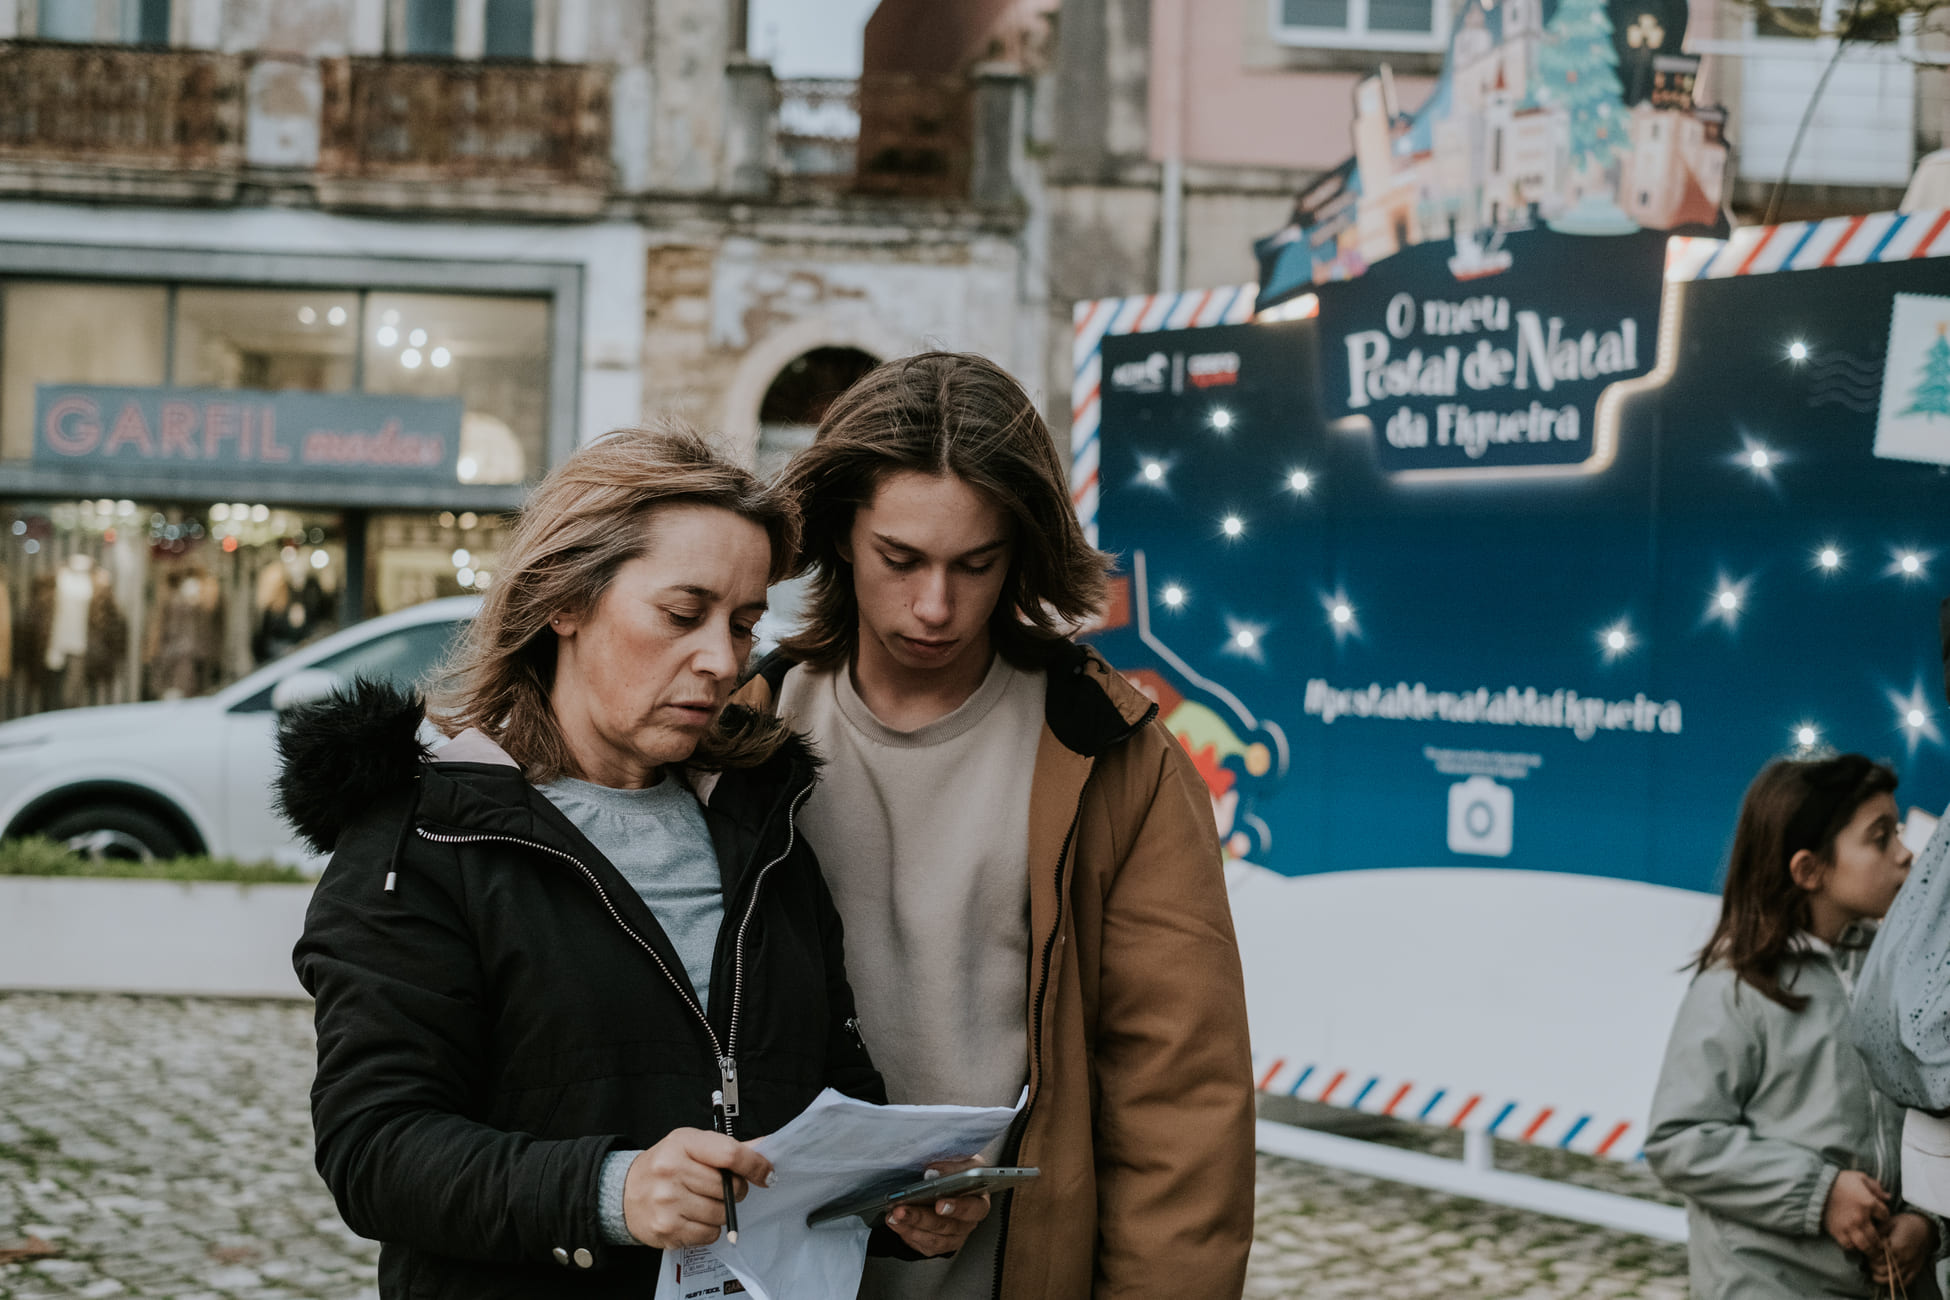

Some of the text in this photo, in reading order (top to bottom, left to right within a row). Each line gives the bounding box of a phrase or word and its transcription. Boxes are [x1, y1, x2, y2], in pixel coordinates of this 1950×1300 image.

[1386, 292, 1510, 339] O meu
[1344, 310, 1638, 408] Postal de Natal
[44, 394, 291, 464] GARFIL
[1385, 401, 1580, 459] da Figueira
